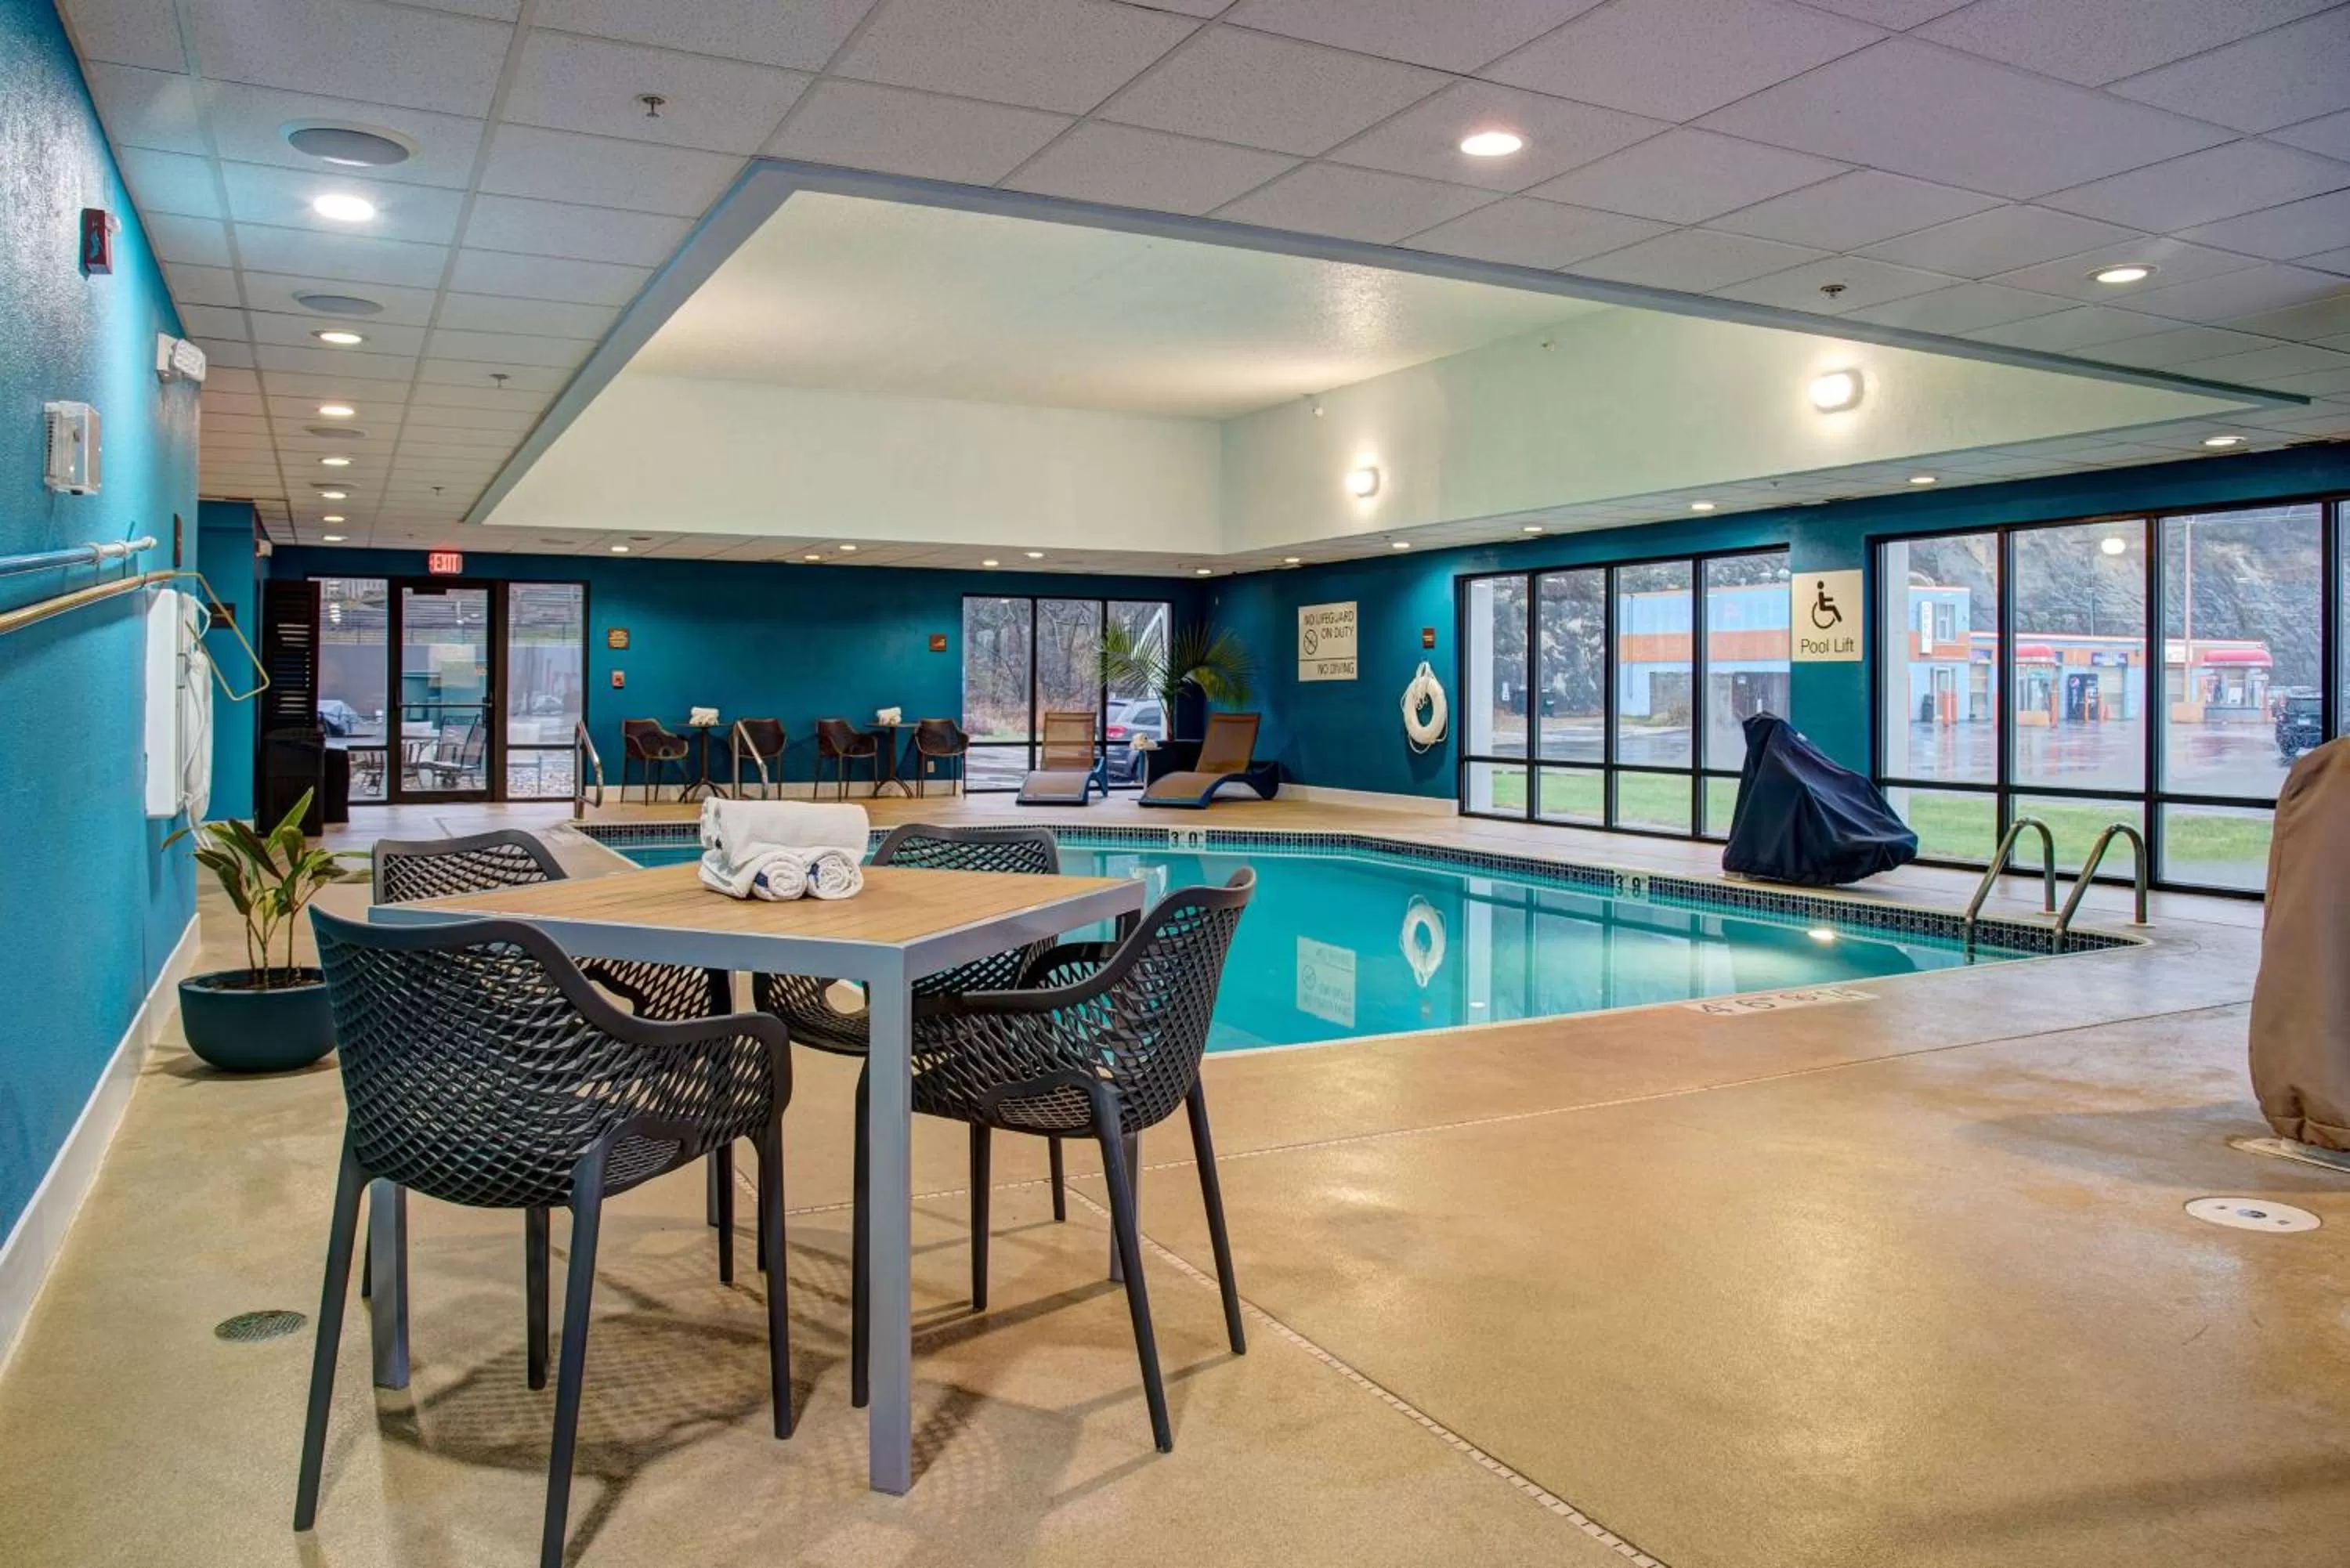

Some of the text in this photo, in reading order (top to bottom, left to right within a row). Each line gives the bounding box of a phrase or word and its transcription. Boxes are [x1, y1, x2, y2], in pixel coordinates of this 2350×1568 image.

[432, 554, 458, 572] EXIT
[1304, 613, 1315, 626] NO
[1320, 626, 1354, 639] ON DUTY
[1801, 637, 1854, 654] Pool Lift
[1317, 662, 1354, 674] NO DIVING
